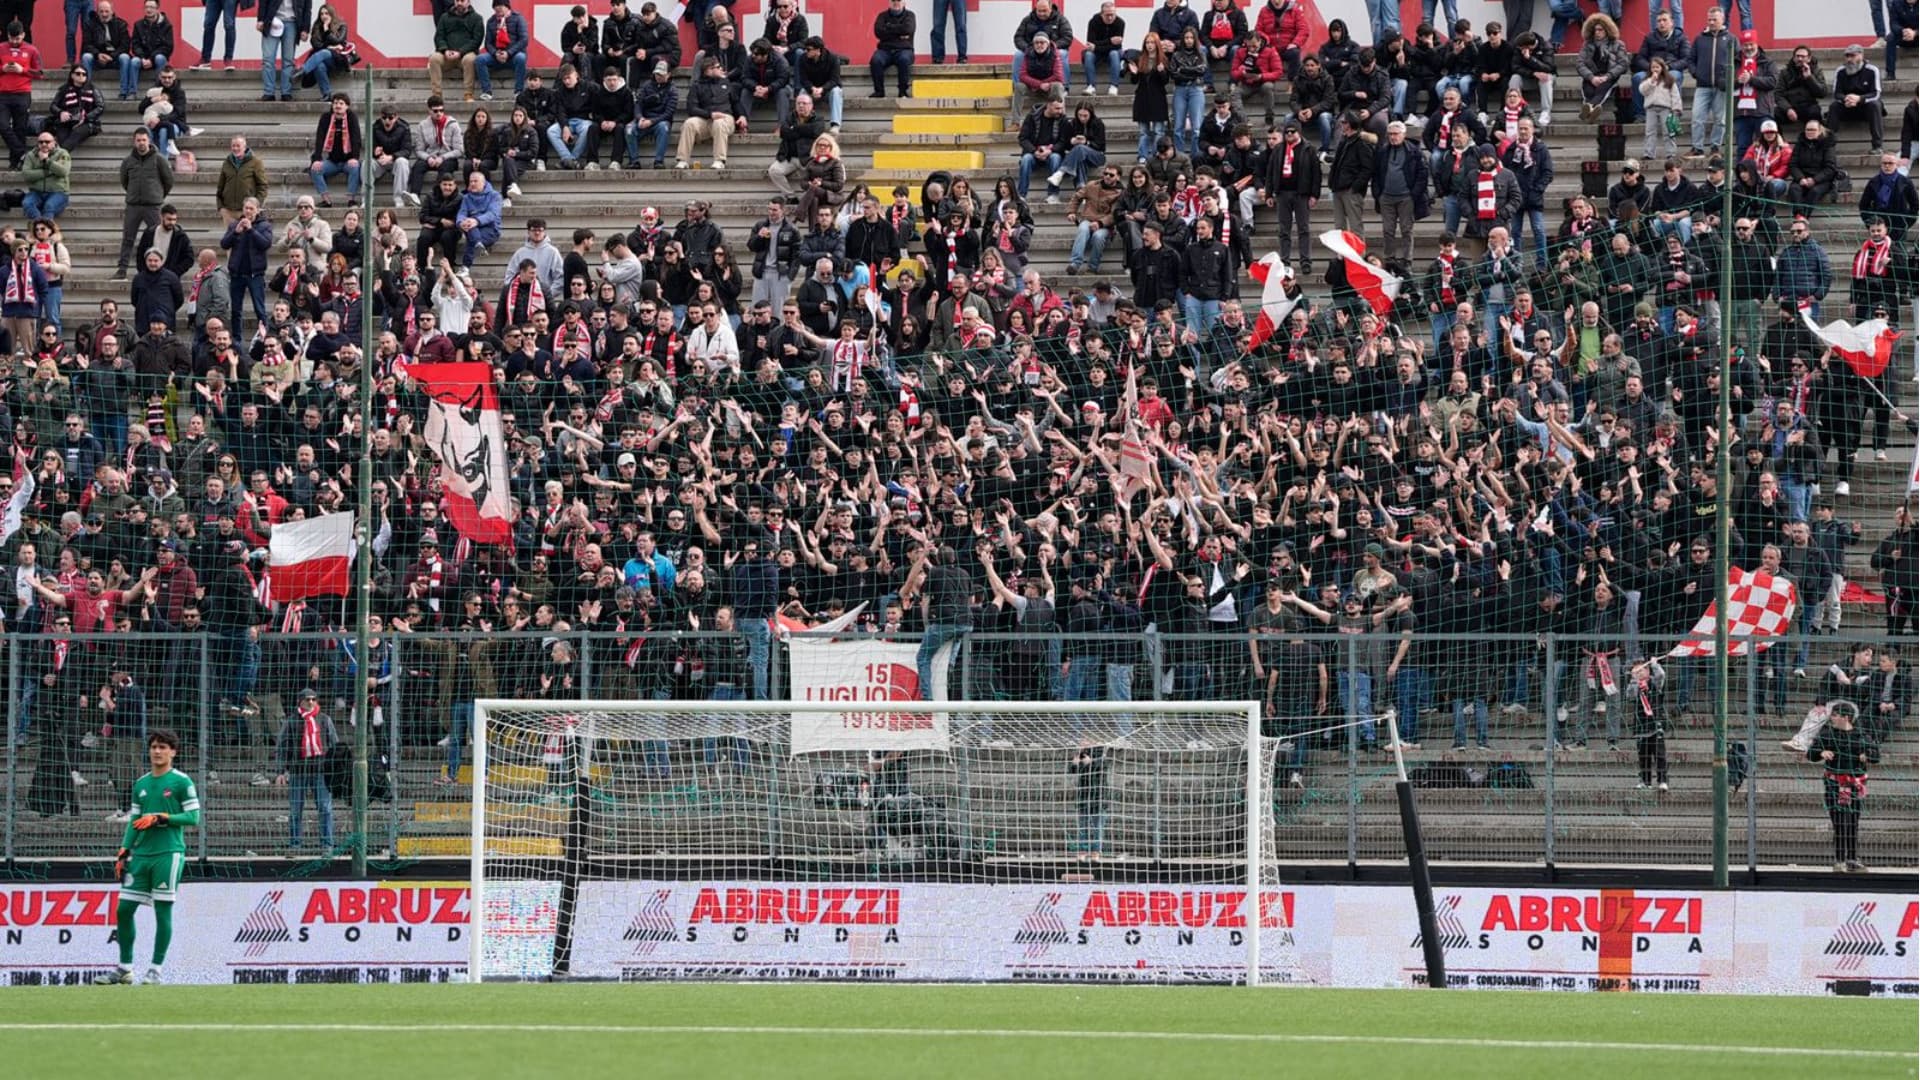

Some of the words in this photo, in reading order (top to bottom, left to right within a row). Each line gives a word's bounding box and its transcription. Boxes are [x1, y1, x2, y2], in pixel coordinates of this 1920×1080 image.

[865, 663, 888, 684] 15
[840, 712, 886, 728] 1913
[301, 889, 470, 924] ABRUZ
[689, 888, 899, 924] ABRUZZI
[1481, 895, 1702, 934] ABRUZZI
